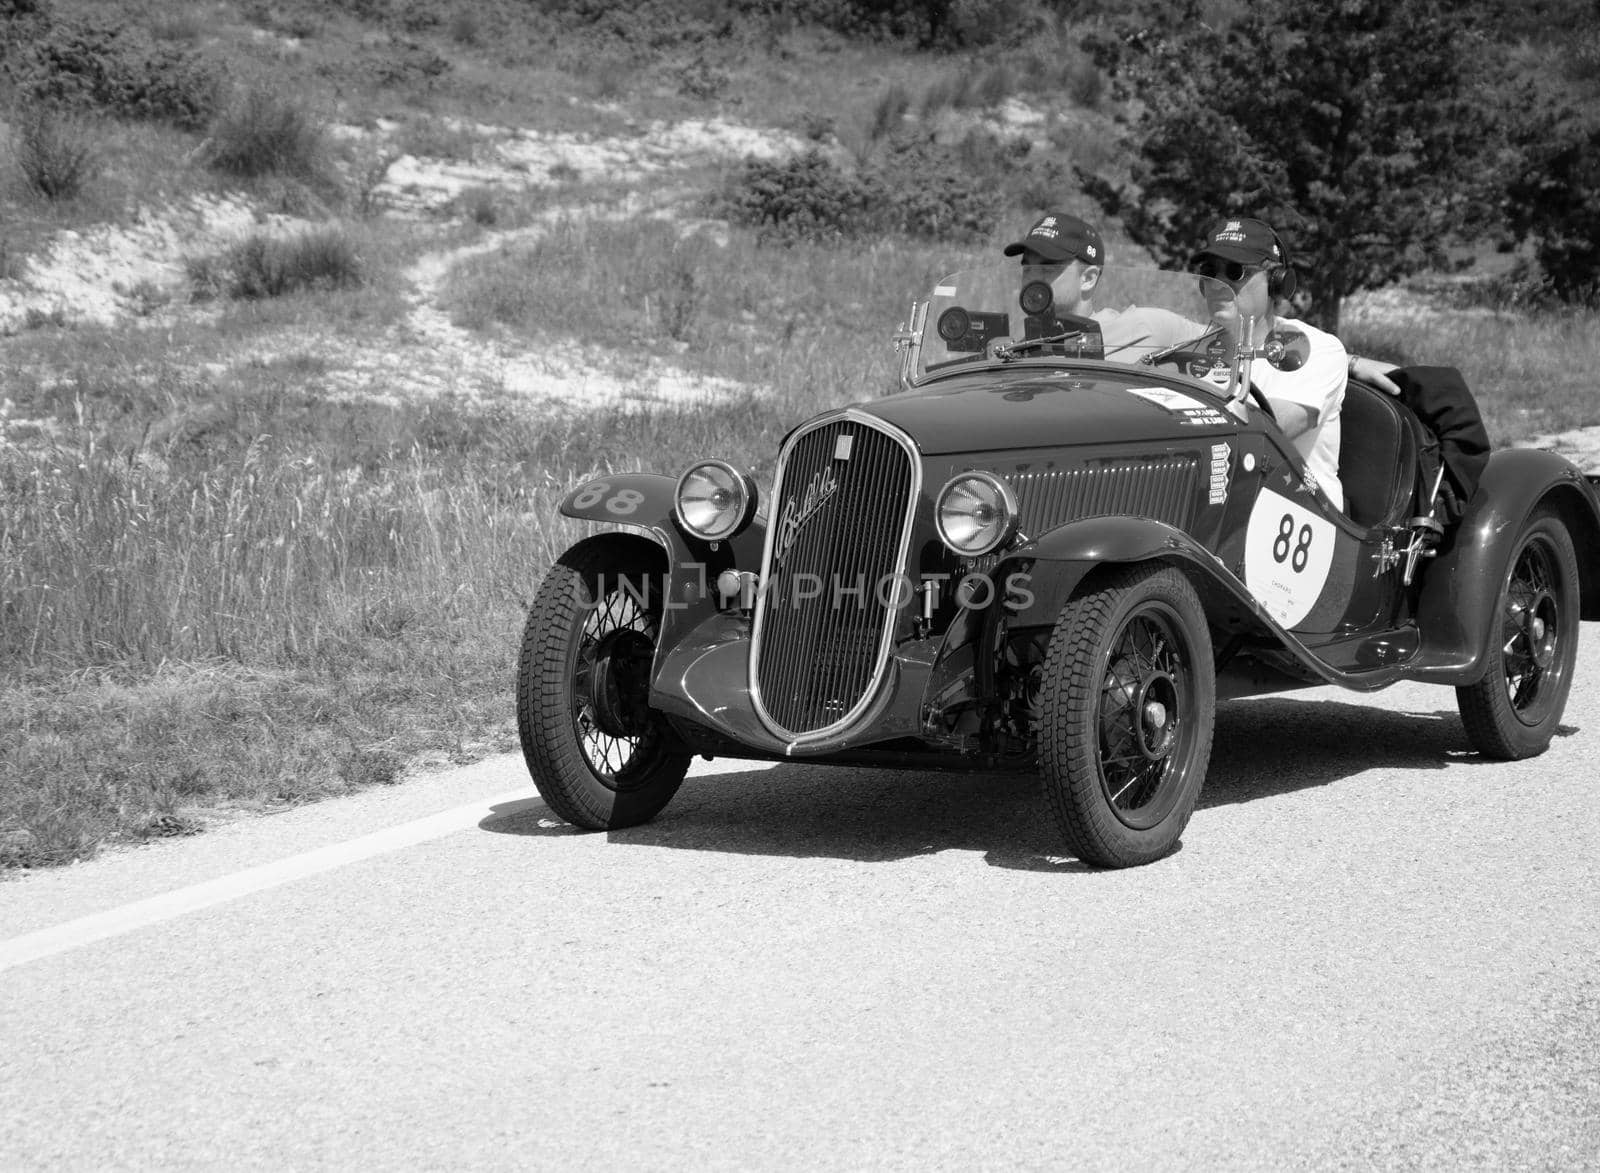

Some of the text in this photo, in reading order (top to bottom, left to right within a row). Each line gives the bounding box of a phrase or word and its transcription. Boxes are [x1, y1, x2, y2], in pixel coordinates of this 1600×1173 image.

[1086, 244, 1097, 258] 88
[573, 482, 645, 515] 88
[1273, 513, 1313, 574] 88
